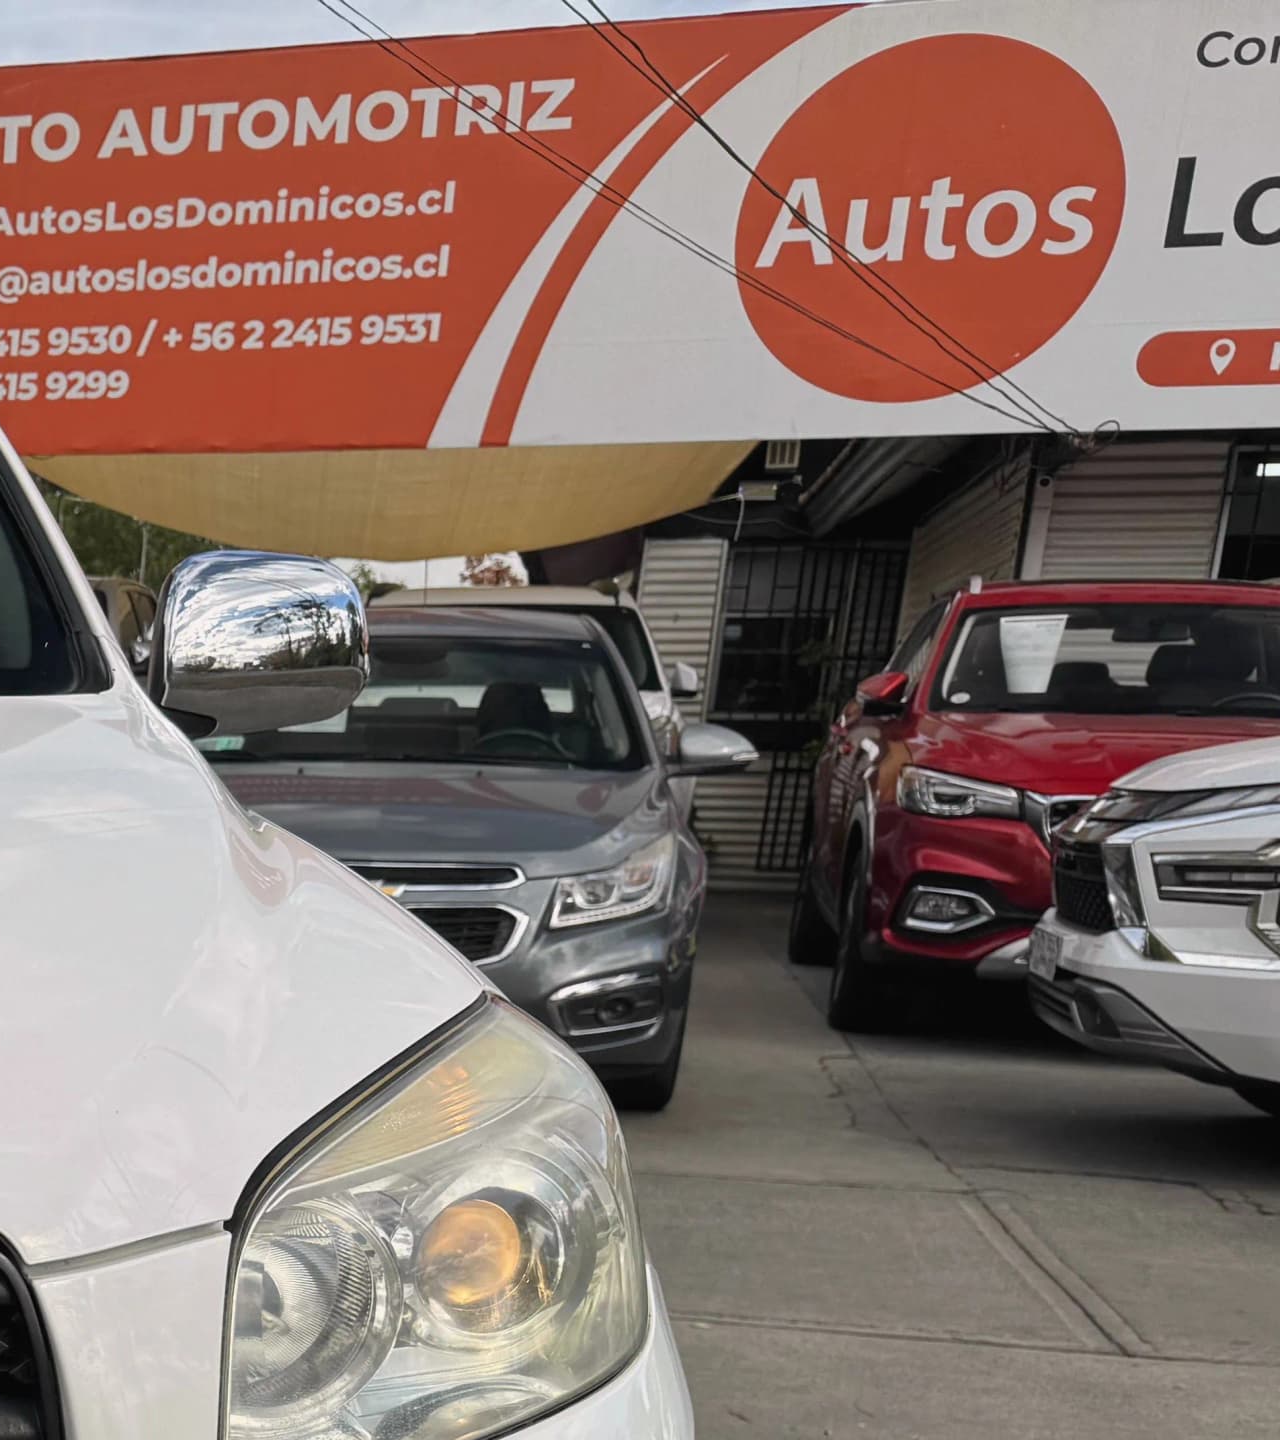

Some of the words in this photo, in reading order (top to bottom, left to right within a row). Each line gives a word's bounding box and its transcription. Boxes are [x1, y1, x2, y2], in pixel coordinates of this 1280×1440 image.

[97, 77, 576, 159] AUTOMOTRIZ
[754, 176, 1097, 268] Autos
[47, 325, 132, 356] 9530
[136, 318, 158, 357] /
[163, 327, 183, 348] +
[190, 321, 235, 352] 56
[241, 319, 265, 350] 2
[270, 316, 352, 348] 2415
[360, 312, 442, 345] 9531
[45, 370, 130, 401] 9299
